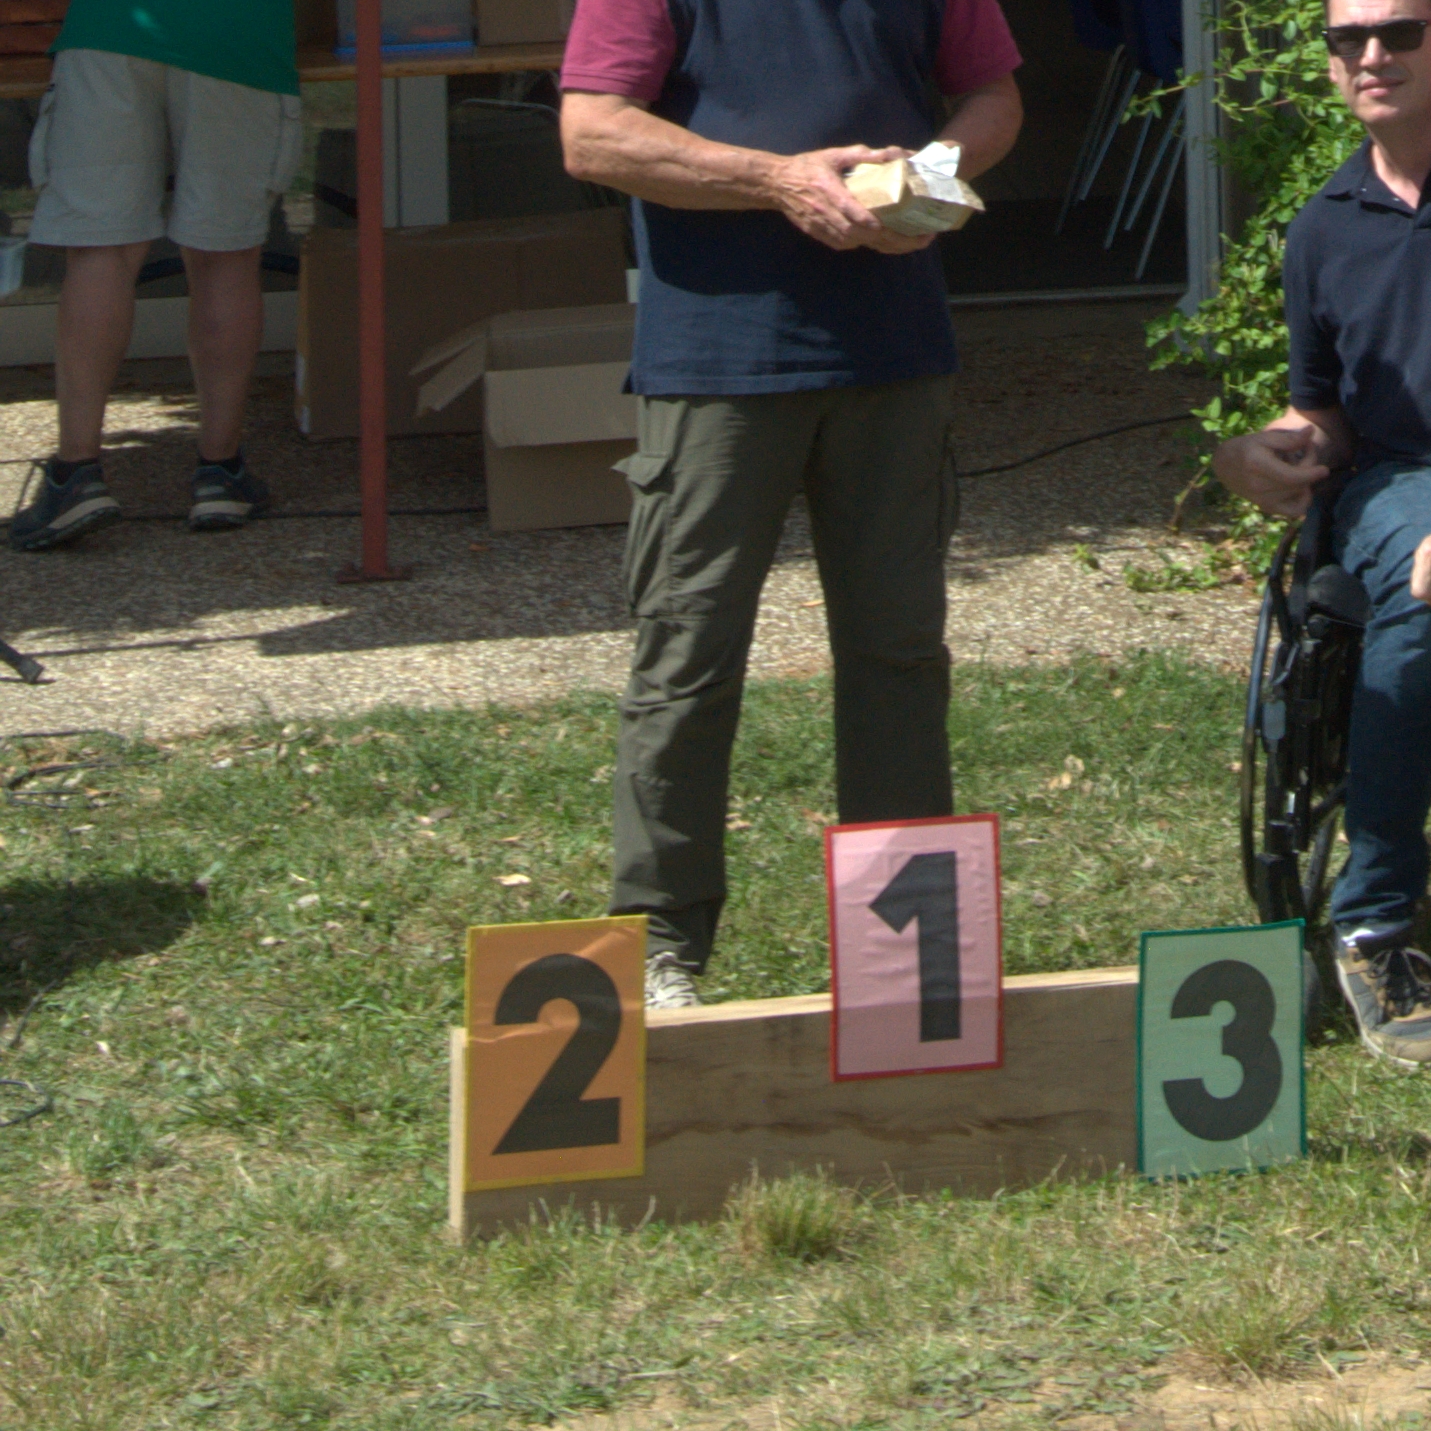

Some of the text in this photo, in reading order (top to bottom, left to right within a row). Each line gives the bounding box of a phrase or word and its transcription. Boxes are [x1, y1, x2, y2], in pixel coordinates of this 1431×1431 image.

[869, 851, 961, 1043] 1
[490, 953, 621, 1156] 2
[1162, 959, 1283, 1142] 3
